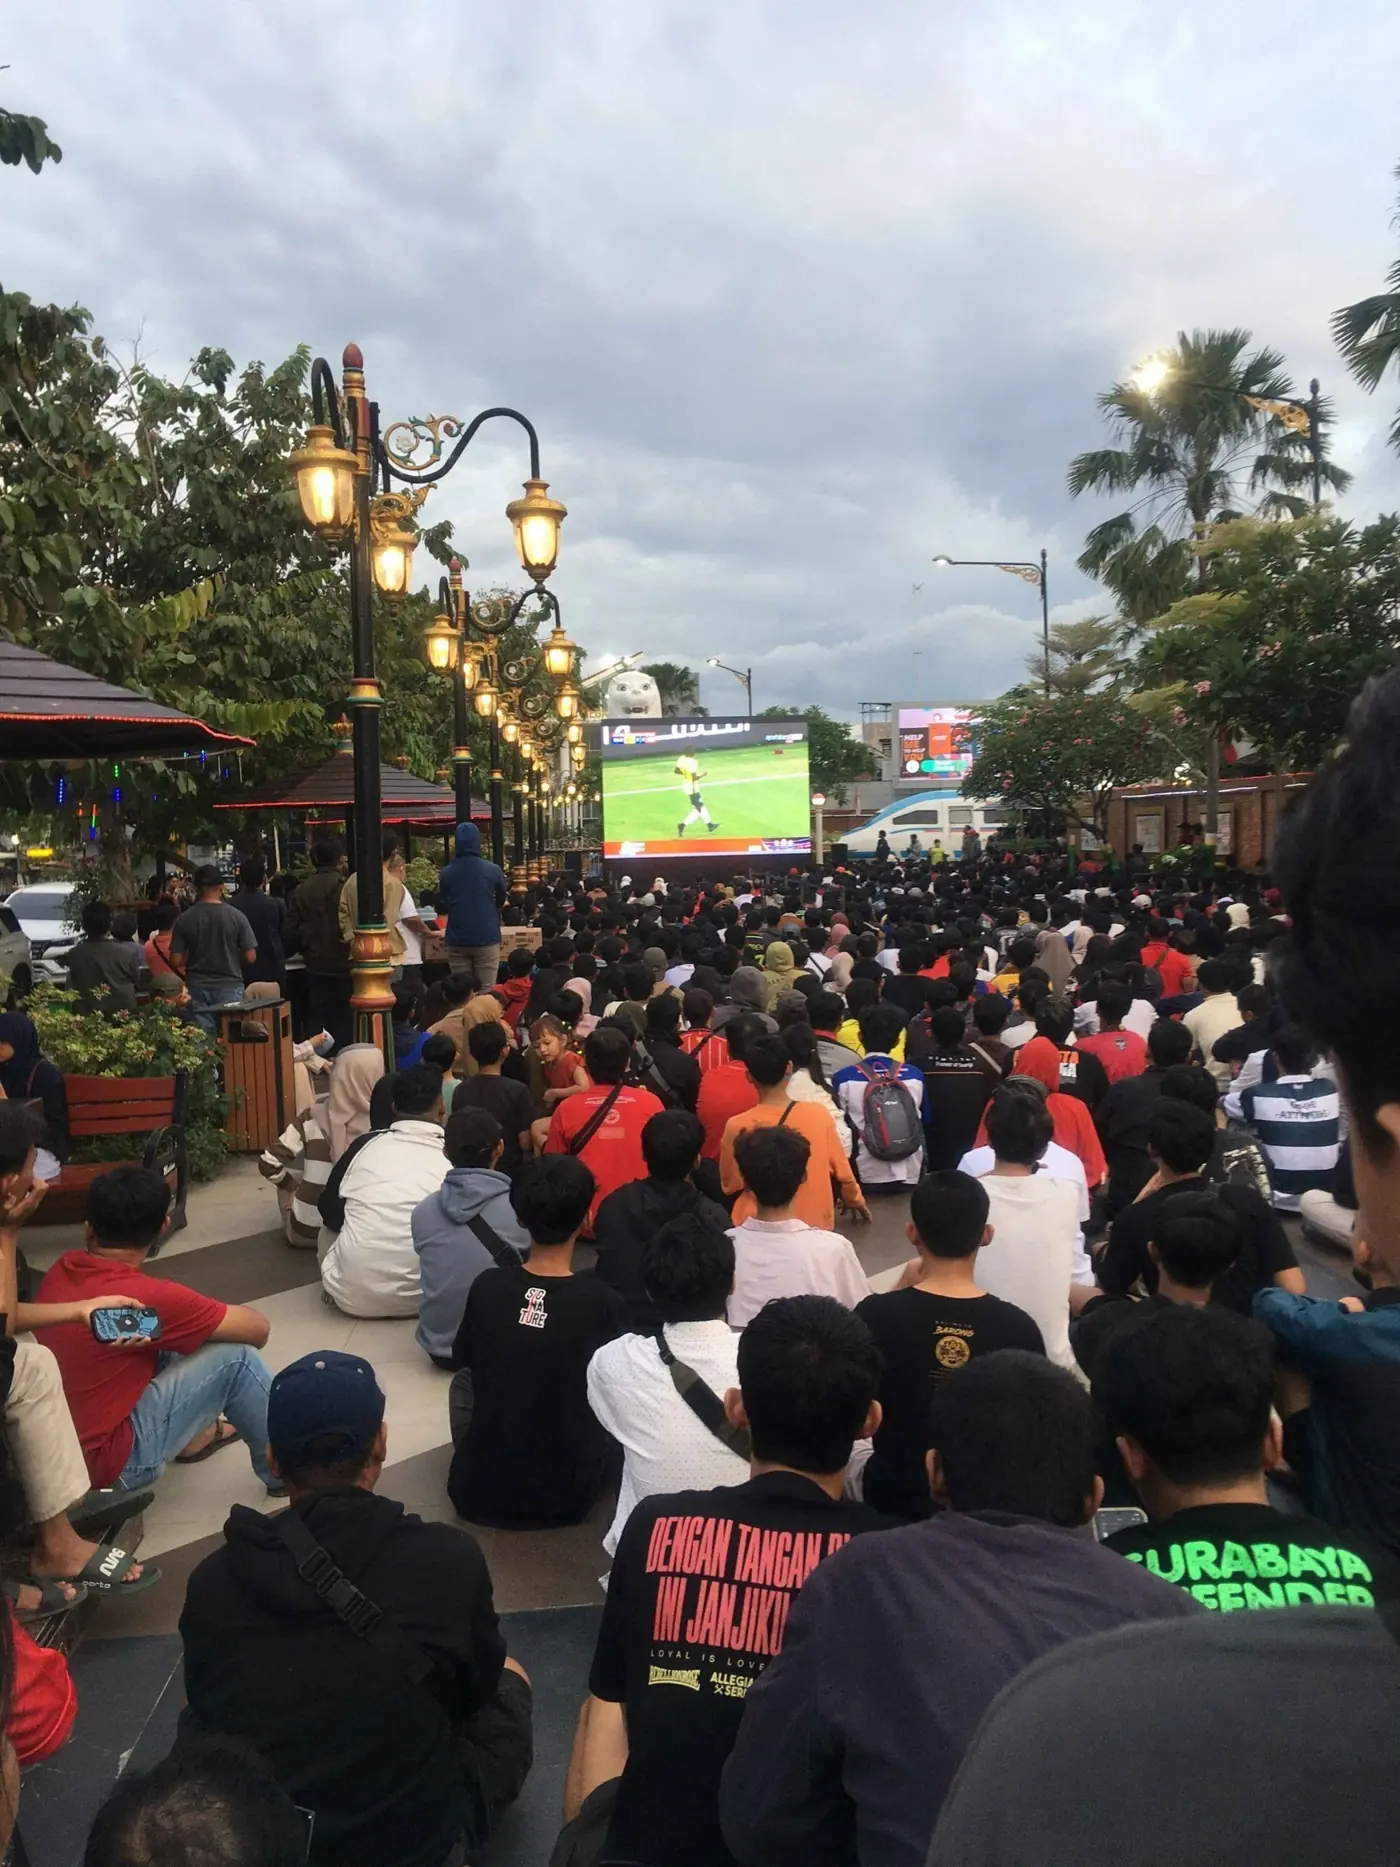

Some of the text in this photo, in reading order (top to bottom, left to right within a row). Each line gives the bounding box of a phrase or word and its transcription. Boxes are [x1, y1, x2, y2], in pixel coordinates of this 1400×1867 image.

[646, 1516, 822, 1589] DENGAN TANGAN
[1124, 1540, 1373, 1583] URABAYA
[653, 1576, 791, 1656] INI JANJIKU
[1181, 1582, 1375, 1612] FENDER
[650, 1649, 765, 1671] LOYAL IS LOVE
